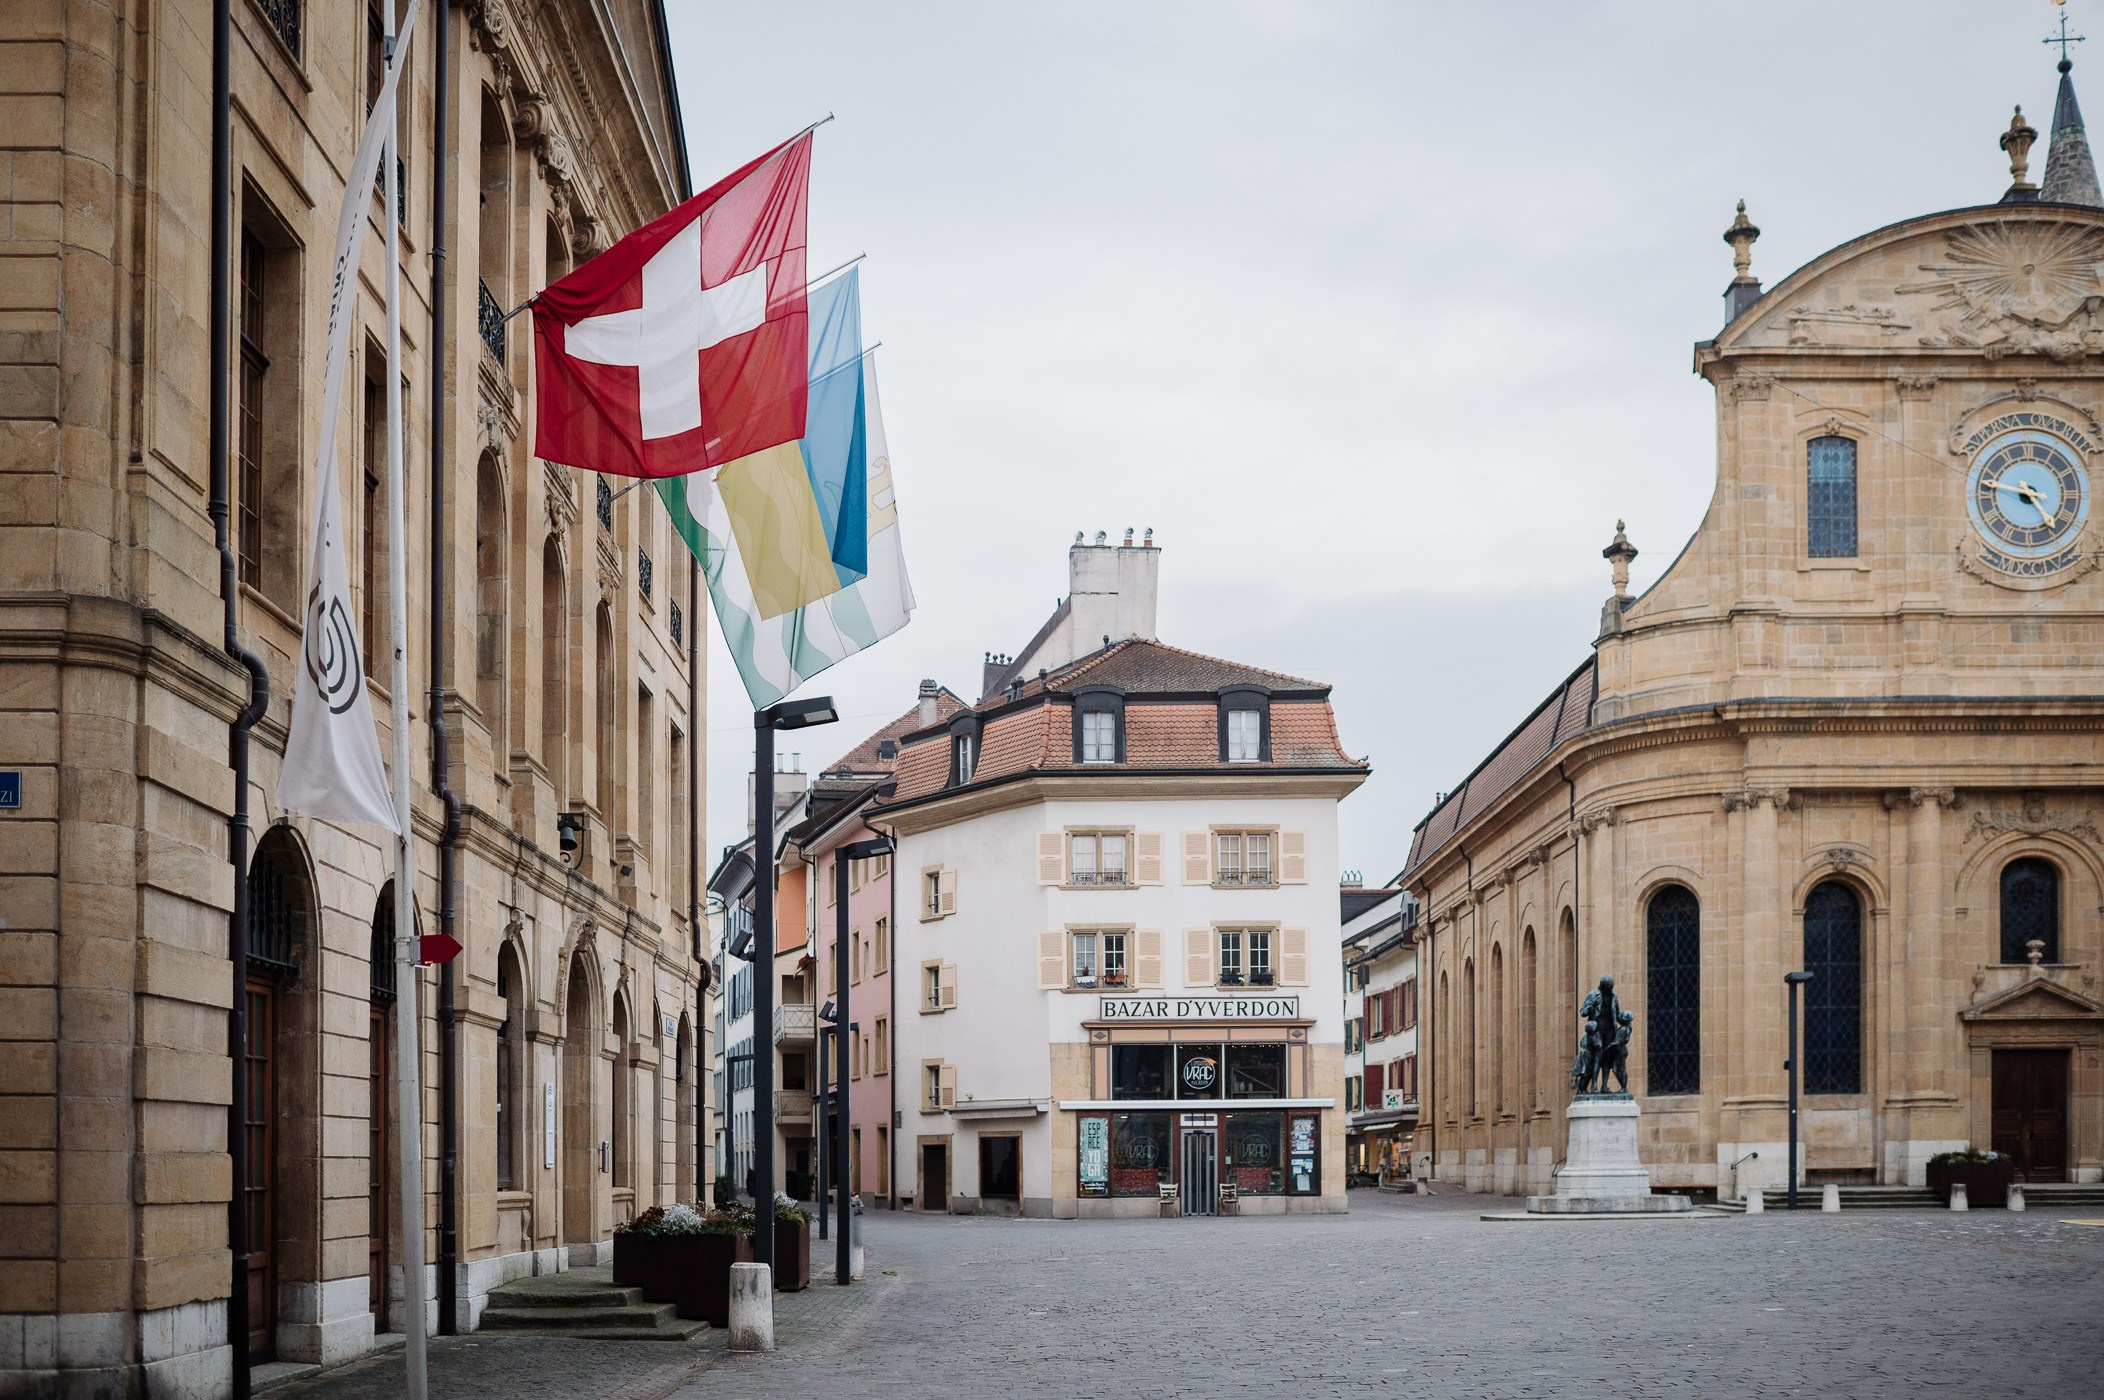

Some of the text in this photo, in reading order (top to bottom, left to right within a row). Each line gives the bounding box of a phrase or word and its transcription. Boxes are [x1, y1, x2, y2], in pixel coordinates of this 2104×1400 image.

[1966, 414, 2022, 452] SVPERNA
[1998, 556, 2061, 576] MDCCLV
[1104, 1001, 1169, 1017] BAZAR
[1186, 1065, 1213, 1081] VRAC
[1088, 1122, 1101, 1136] ESP
[1088, 1150, 1101, 1163] YO
[1129, 1145, 1156, 1159] VRAC
[1242, 1143, 1269, 1158] VRAC
[1088, 1163, 1101, 1177] GA
